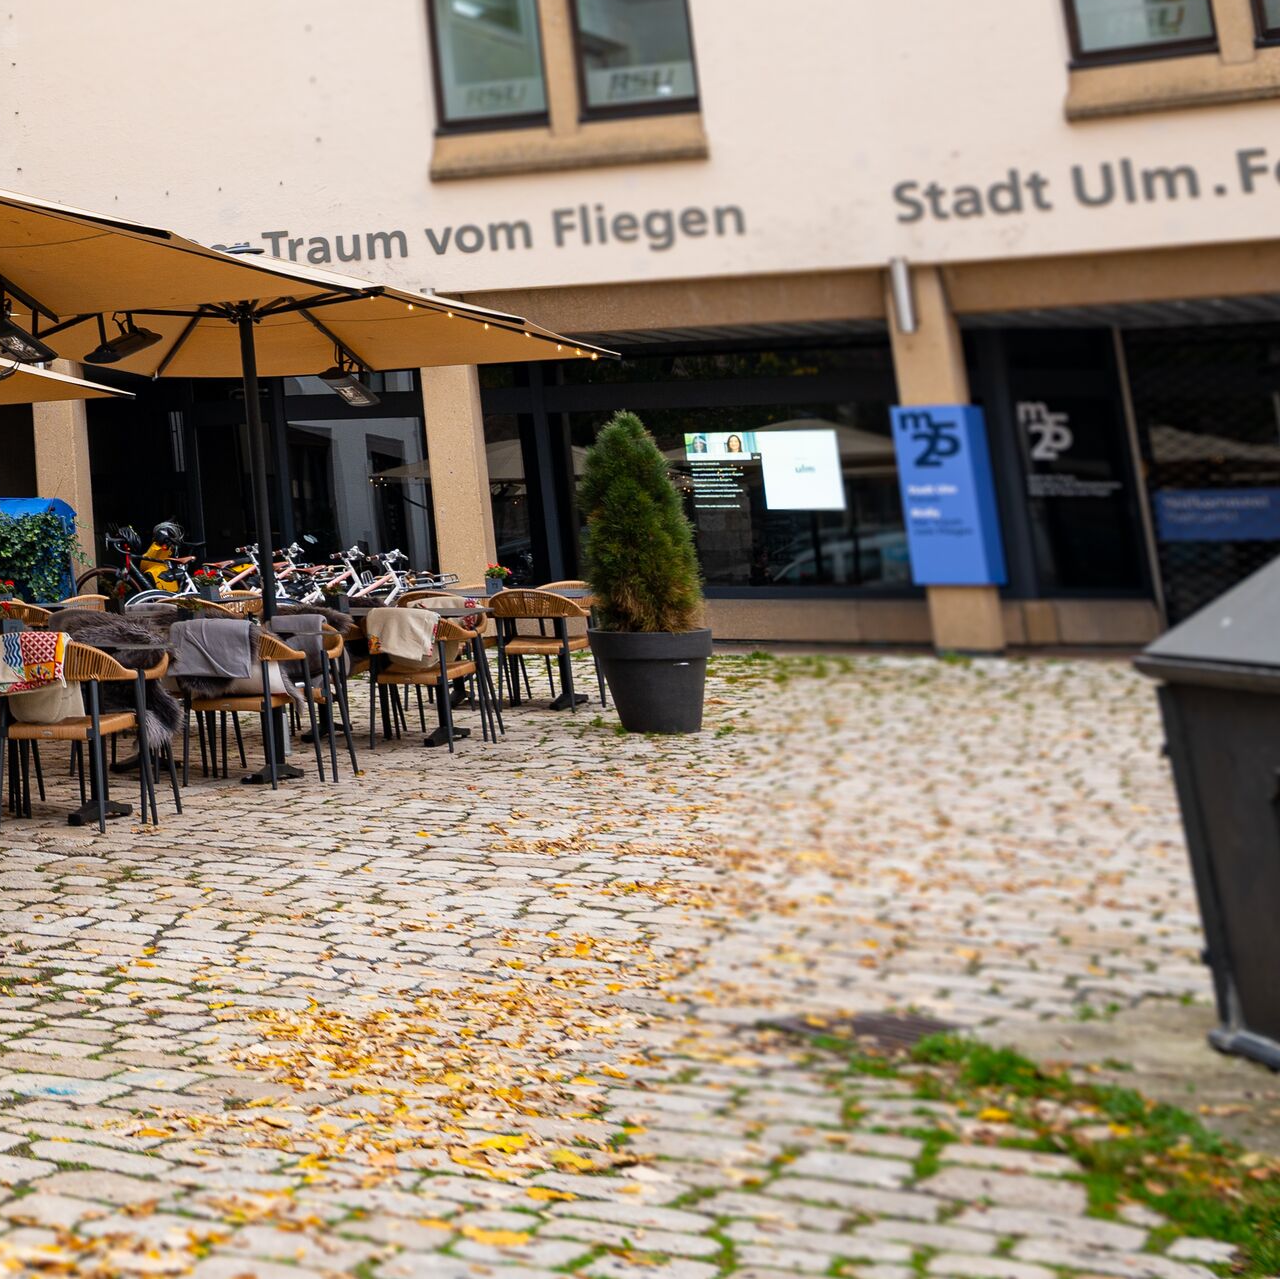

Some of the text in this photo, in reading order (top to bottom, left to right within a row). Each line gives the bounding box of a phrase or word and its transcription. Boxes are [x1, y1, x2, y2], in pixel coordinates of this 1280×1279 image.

[892, 167, 1053, 224] Stadt
[1237, 147, 1280, 195] F
[261, 202, 747, 265] Traum vom Fliegen
